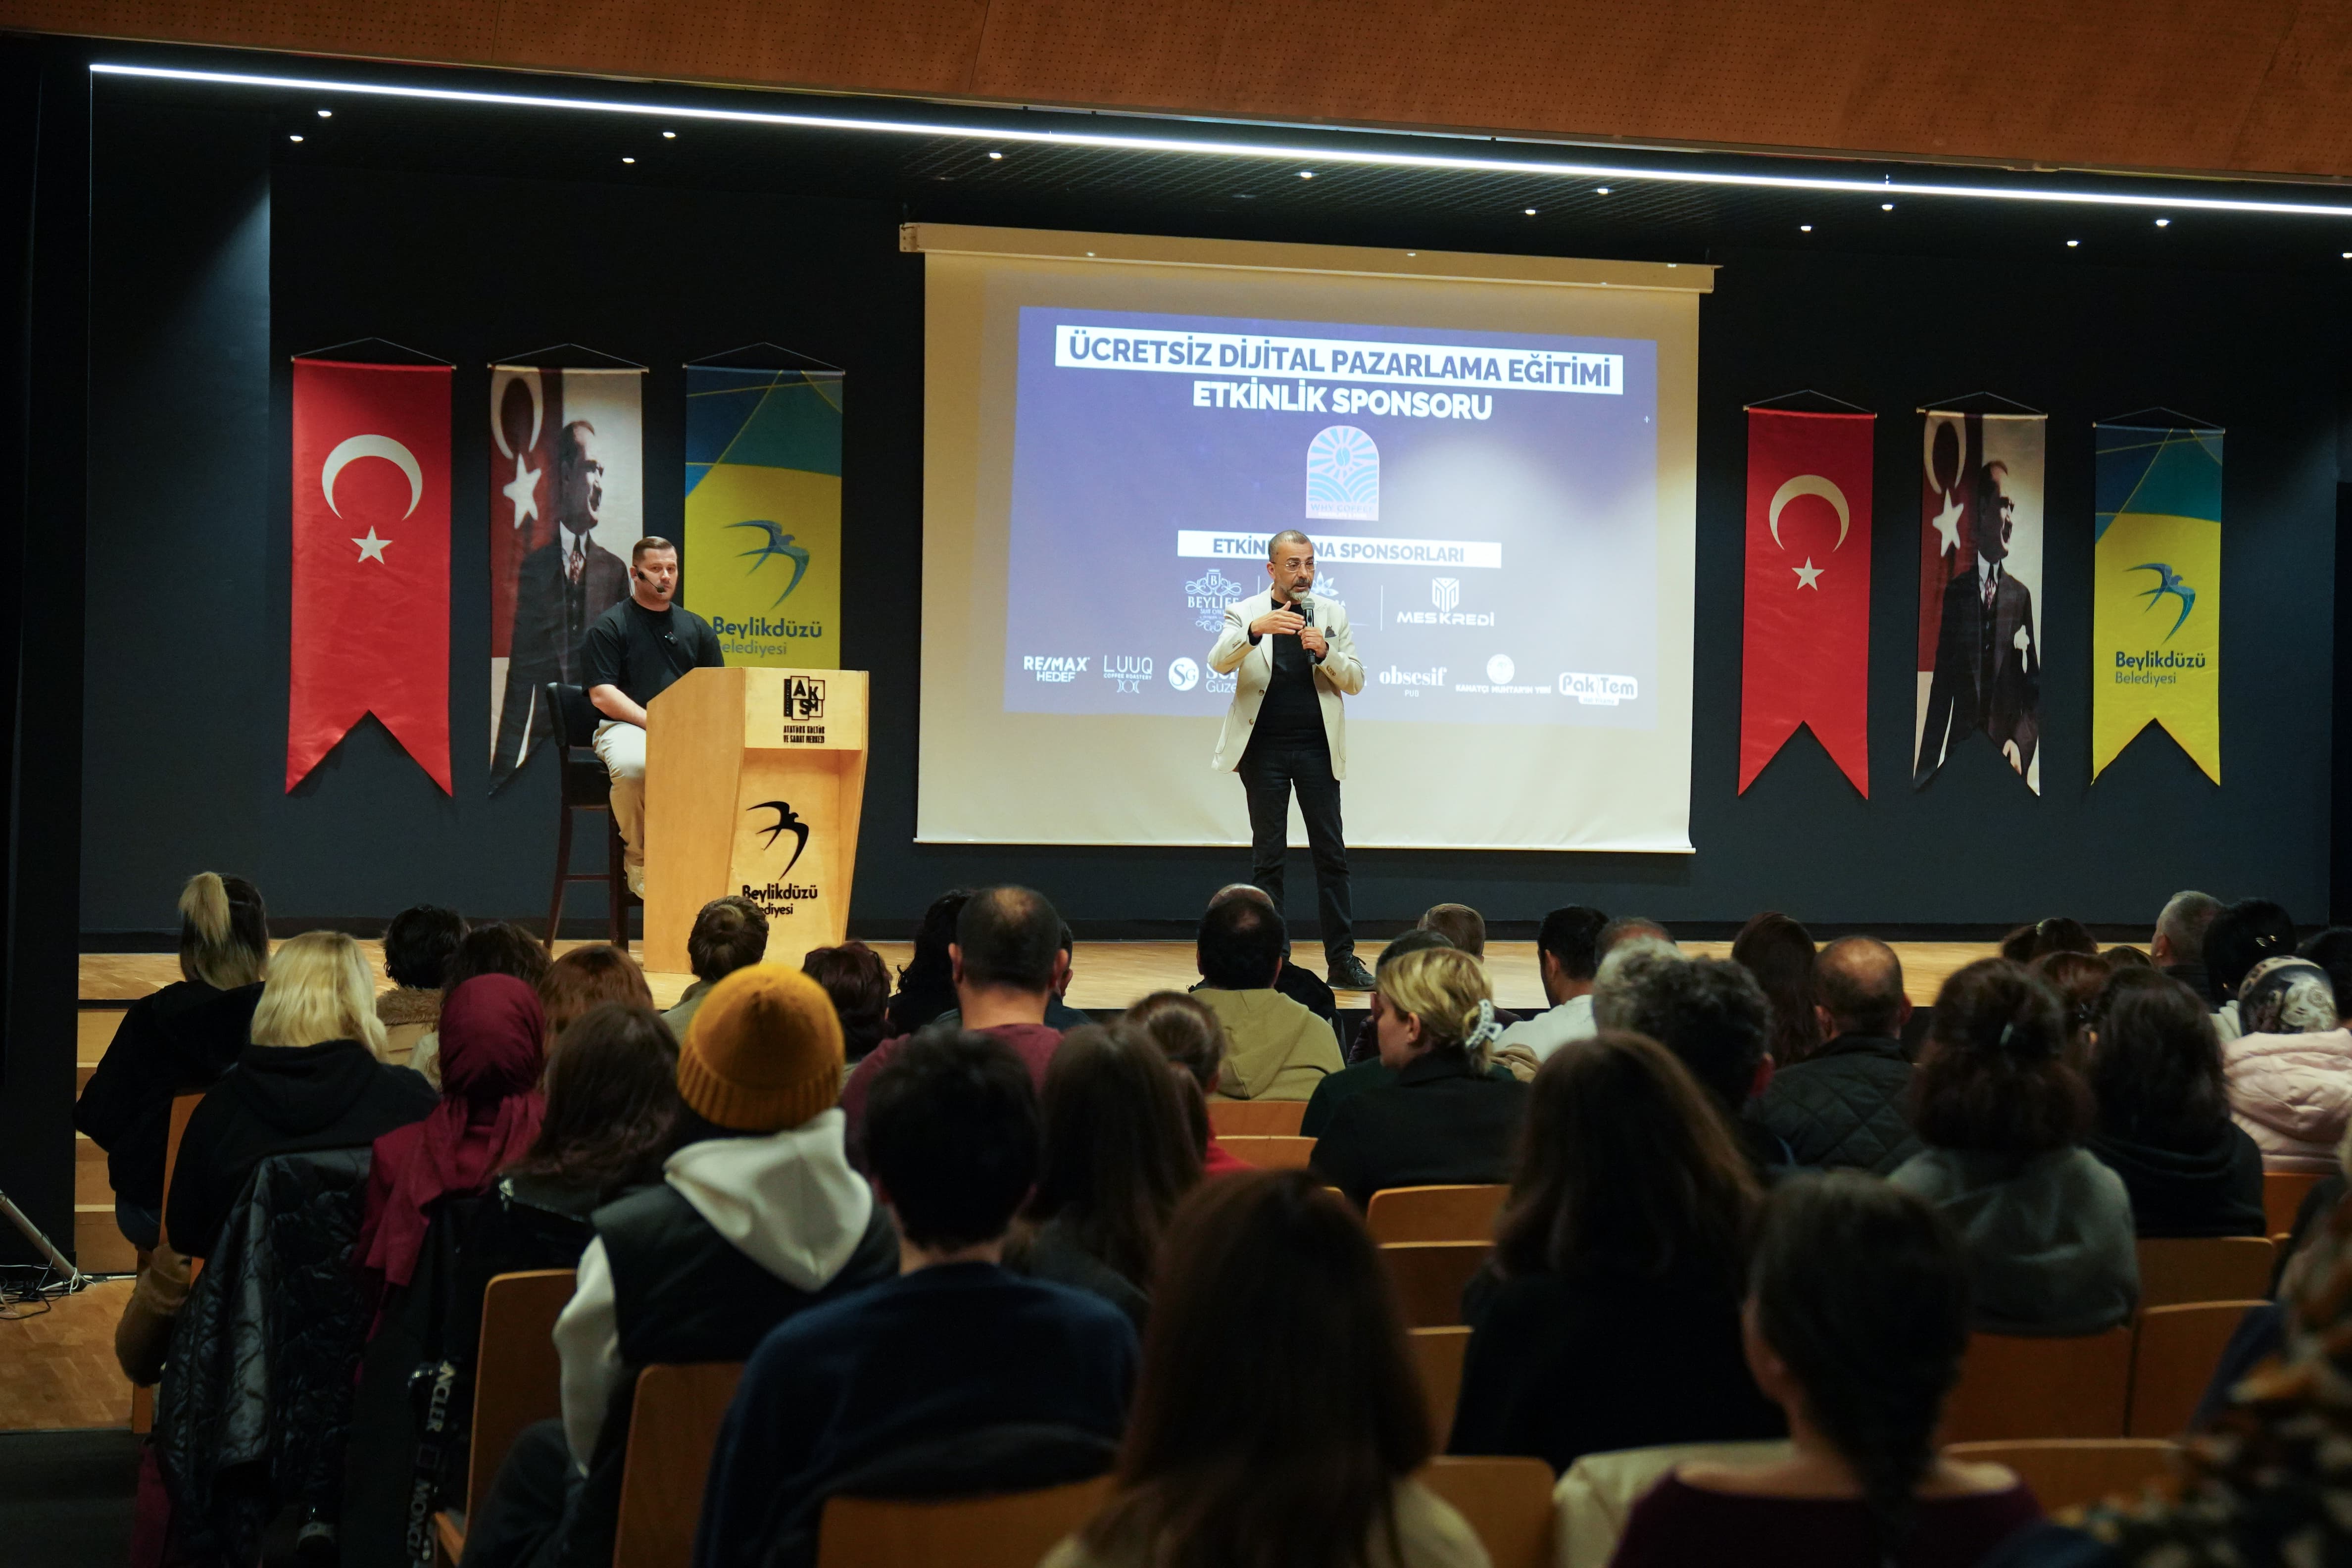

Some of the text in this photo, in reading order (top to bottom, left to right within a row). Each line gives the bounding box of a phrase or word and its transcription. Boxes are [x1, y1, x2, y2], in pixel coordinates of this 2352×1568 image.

[1070, 330, 1611, 387] ÜCRETSİZ DİJİTAL PAZARLAMA EĞİTİMİ
[1193, 377, 1492, 420] ETKİNLİK SPONSORU
[1213, 536, 1464, 563] ETKİN NA SPONSORLARI
[713, 616, 822, 639] Beylikdüzü
[720, 640, 787, 657] elediyesi
[1024, 655, 1087, 671] RE/MAX
[1103, 655, 1153, 675] LUUQ
[2115, 650, 2205, 671] Beylikdüzü
[1036, 671, 1076, 683] HEDEF
[1379, 665, 1447, 686] obsesif
[1563, 675, 1635, 695] Pak Tem
[2115, 671, 2176, 687] Belediyesi
[742, 883, 818, 903] Beylikdüzü
